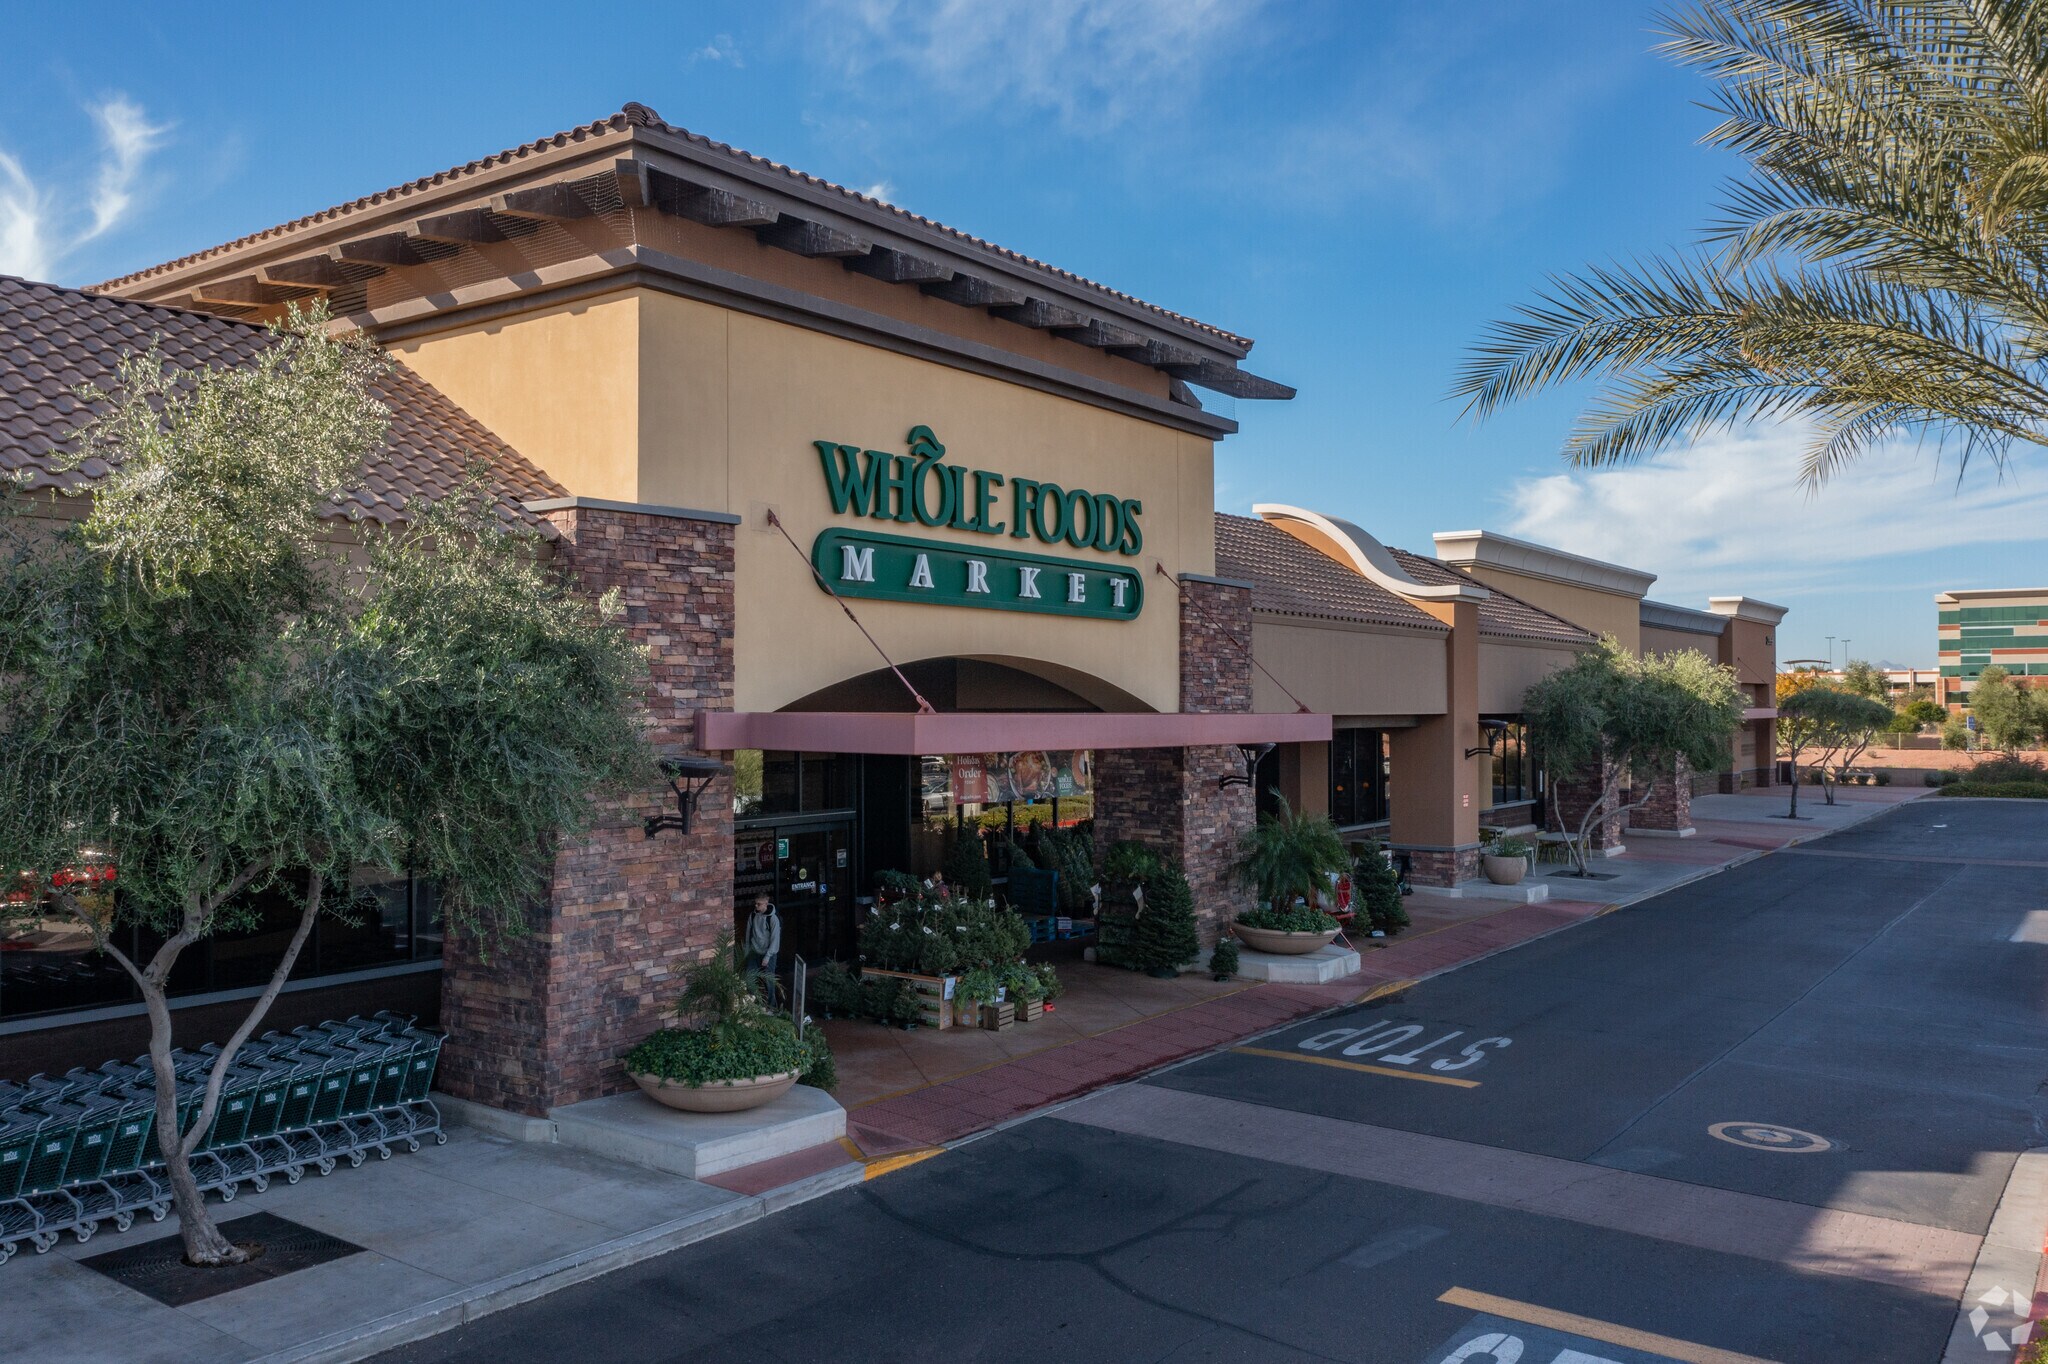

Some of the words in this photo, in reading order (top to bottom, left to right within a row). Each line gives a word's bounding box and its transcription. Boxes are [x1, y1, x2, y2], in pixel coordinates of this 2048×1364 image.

[813, 438, 1005, 535] WHOLE
[1011, 477, 1143, 555] FOODS
[841, 545, 1129, 607] MARKET
[957, 755, 980, 767] Holiday
[958, 767, 982, 779] Order
[791, 881, 816, 890] ENTRANCE
[1297, 1019, 1513, 1071] STOP
